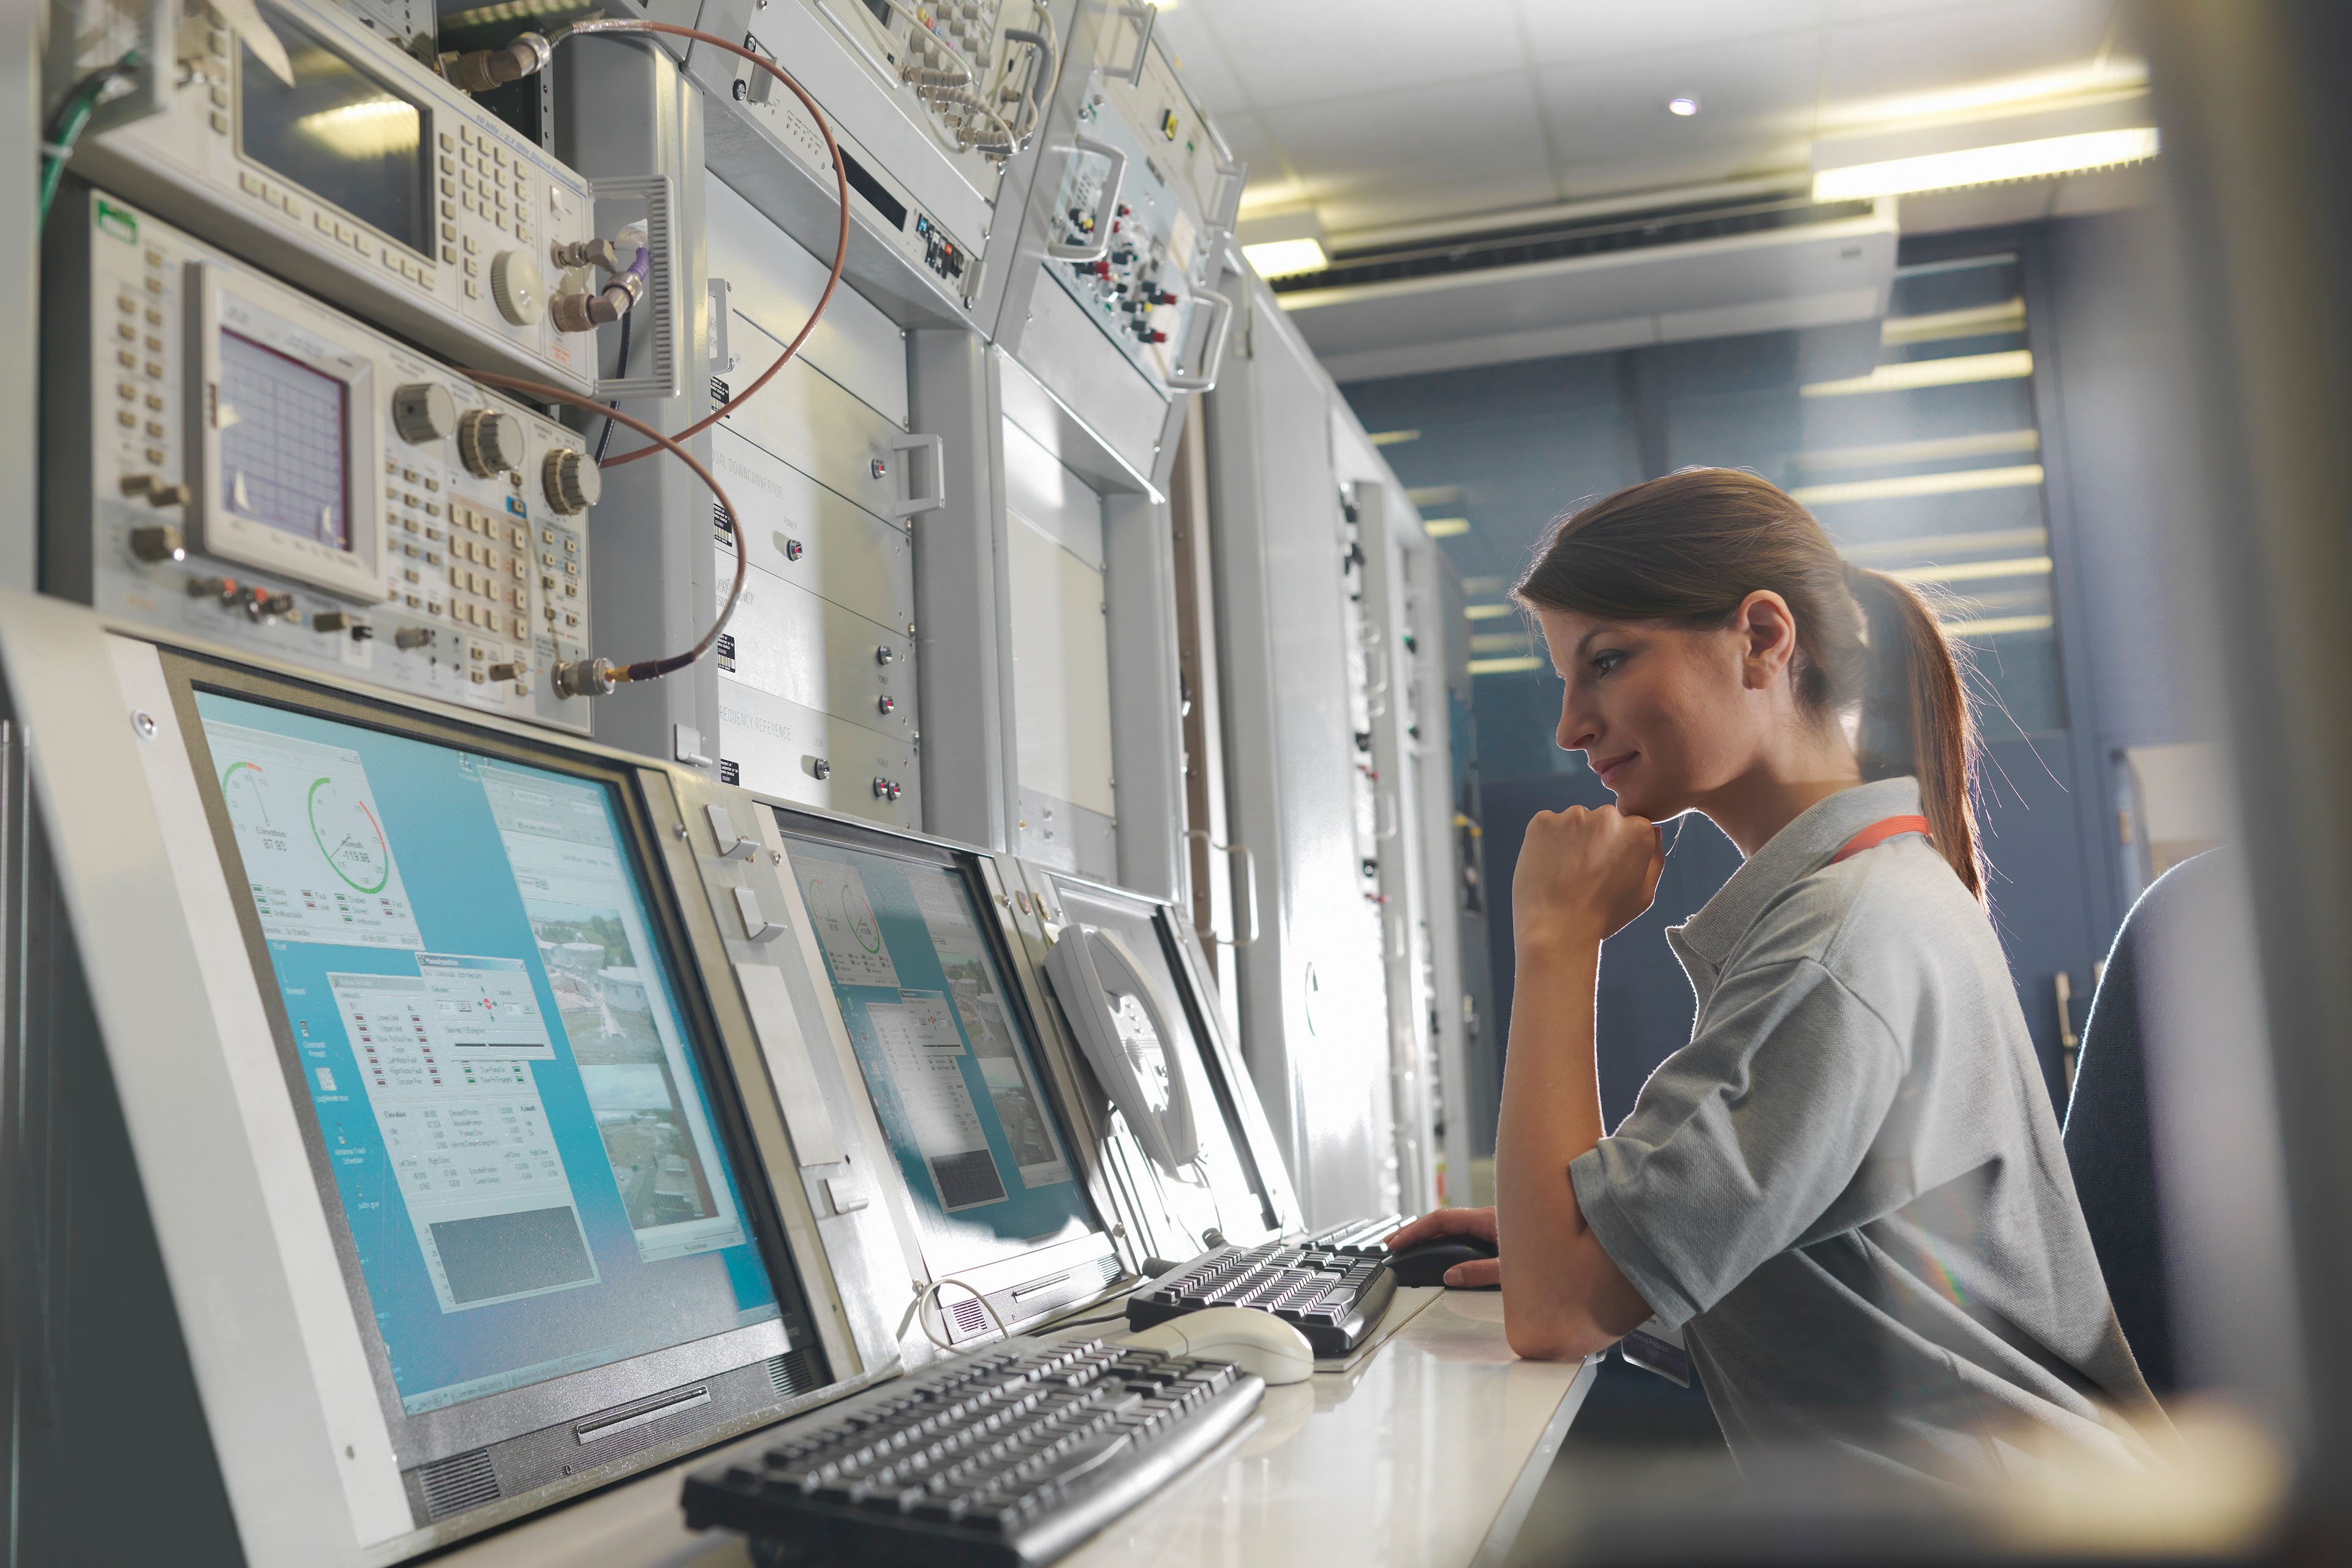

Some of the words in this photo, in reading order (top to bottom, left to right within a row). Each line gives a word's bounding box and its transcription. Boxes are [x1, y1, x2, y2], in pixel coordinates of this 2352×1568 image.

[516, 142, 529, 154] GHz
[531, 152, 551, 169] Signal
[552, 165, 581, 190] Generator
[729, 458, 783, 498] DOWNCONVERTOR
[718, 579, 755, 605] FRENCY
[720, 706, 753, 730] REQUENCY
[755, 717, 791, 741] REFERENCE
[255, 826, 286, 837] Elevation
[262, 839, 287, 851] 87.93
[342, 850, 370, 862] -119.98
